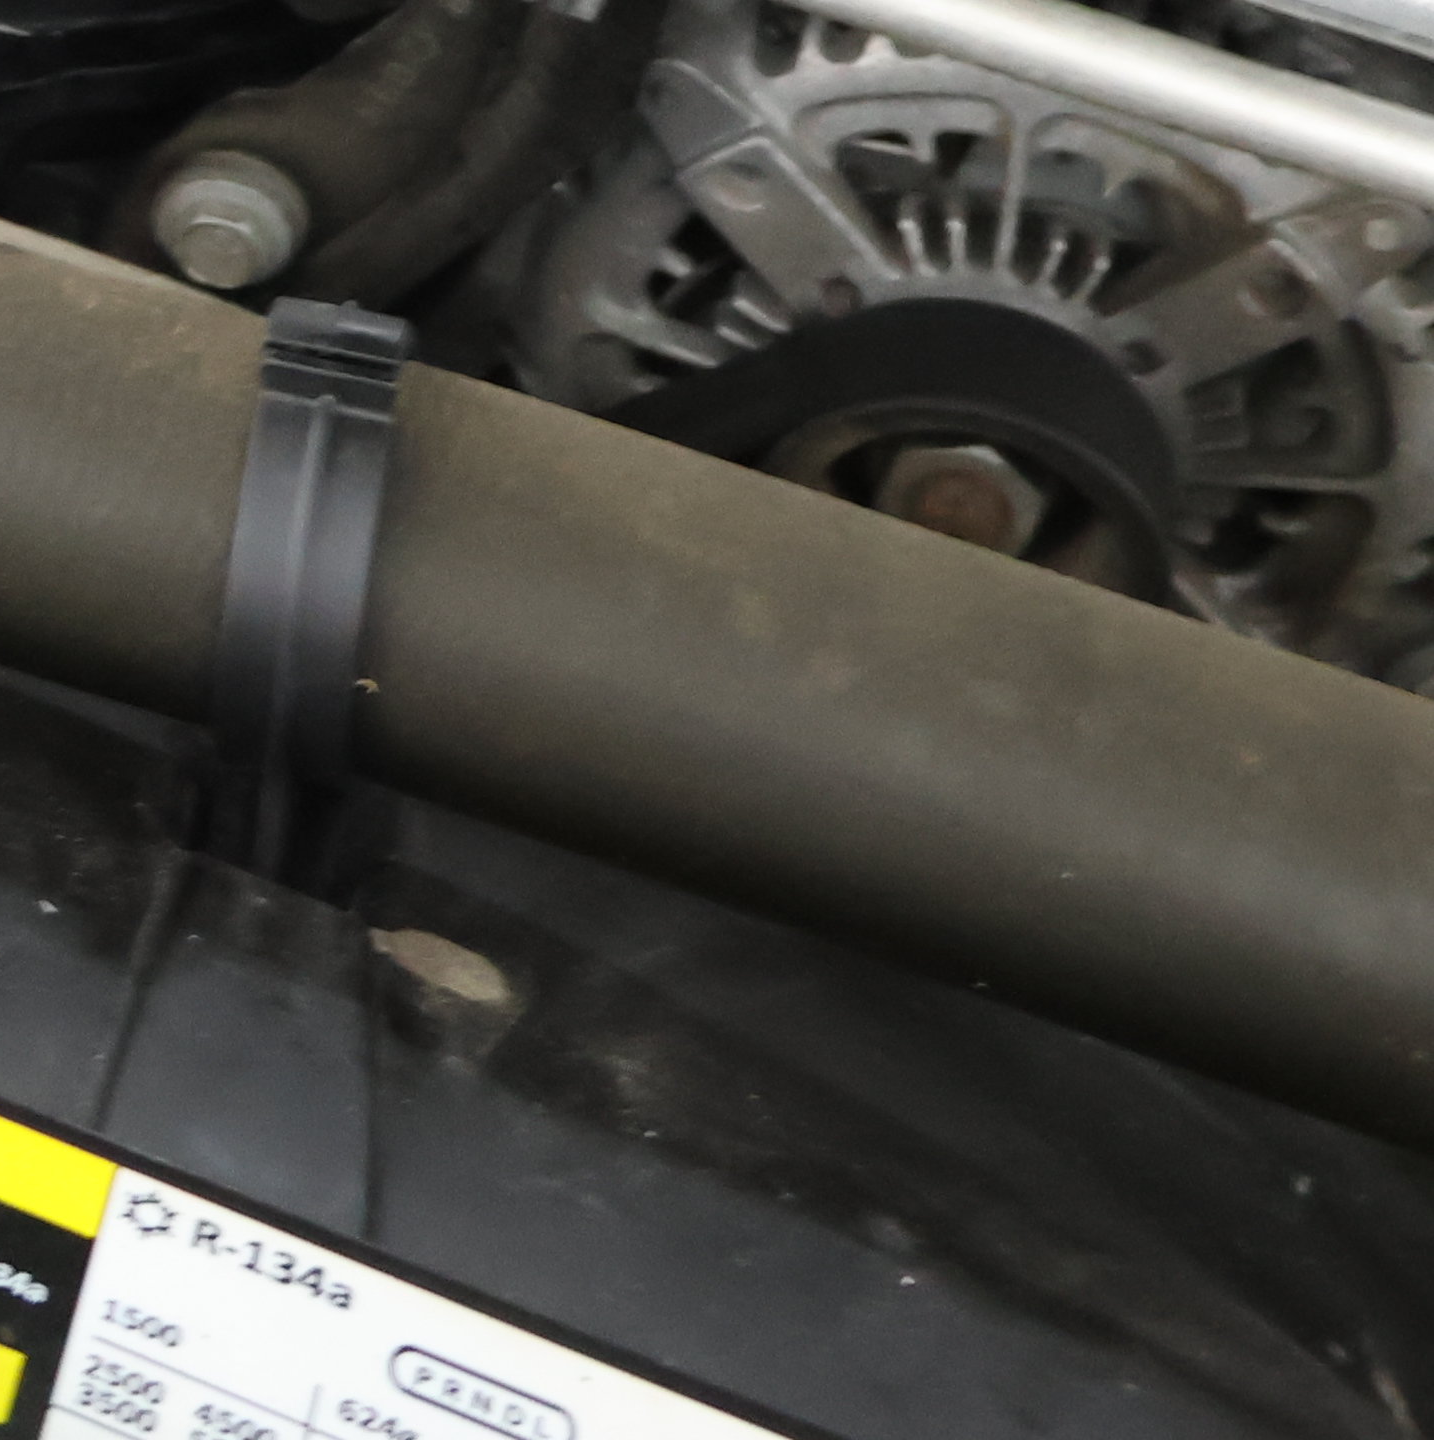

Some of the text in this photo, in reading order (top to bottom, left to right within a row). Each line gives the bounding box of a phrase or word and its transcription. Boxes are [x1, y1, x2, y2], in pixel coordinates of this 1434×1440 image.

[191, 1219, 353, 1309] R-134a
[101, 1299, 182, 1348] 1500
[83, 1353, 164, 1404] 2500
[79, 1381, 157, 1432] 3500
